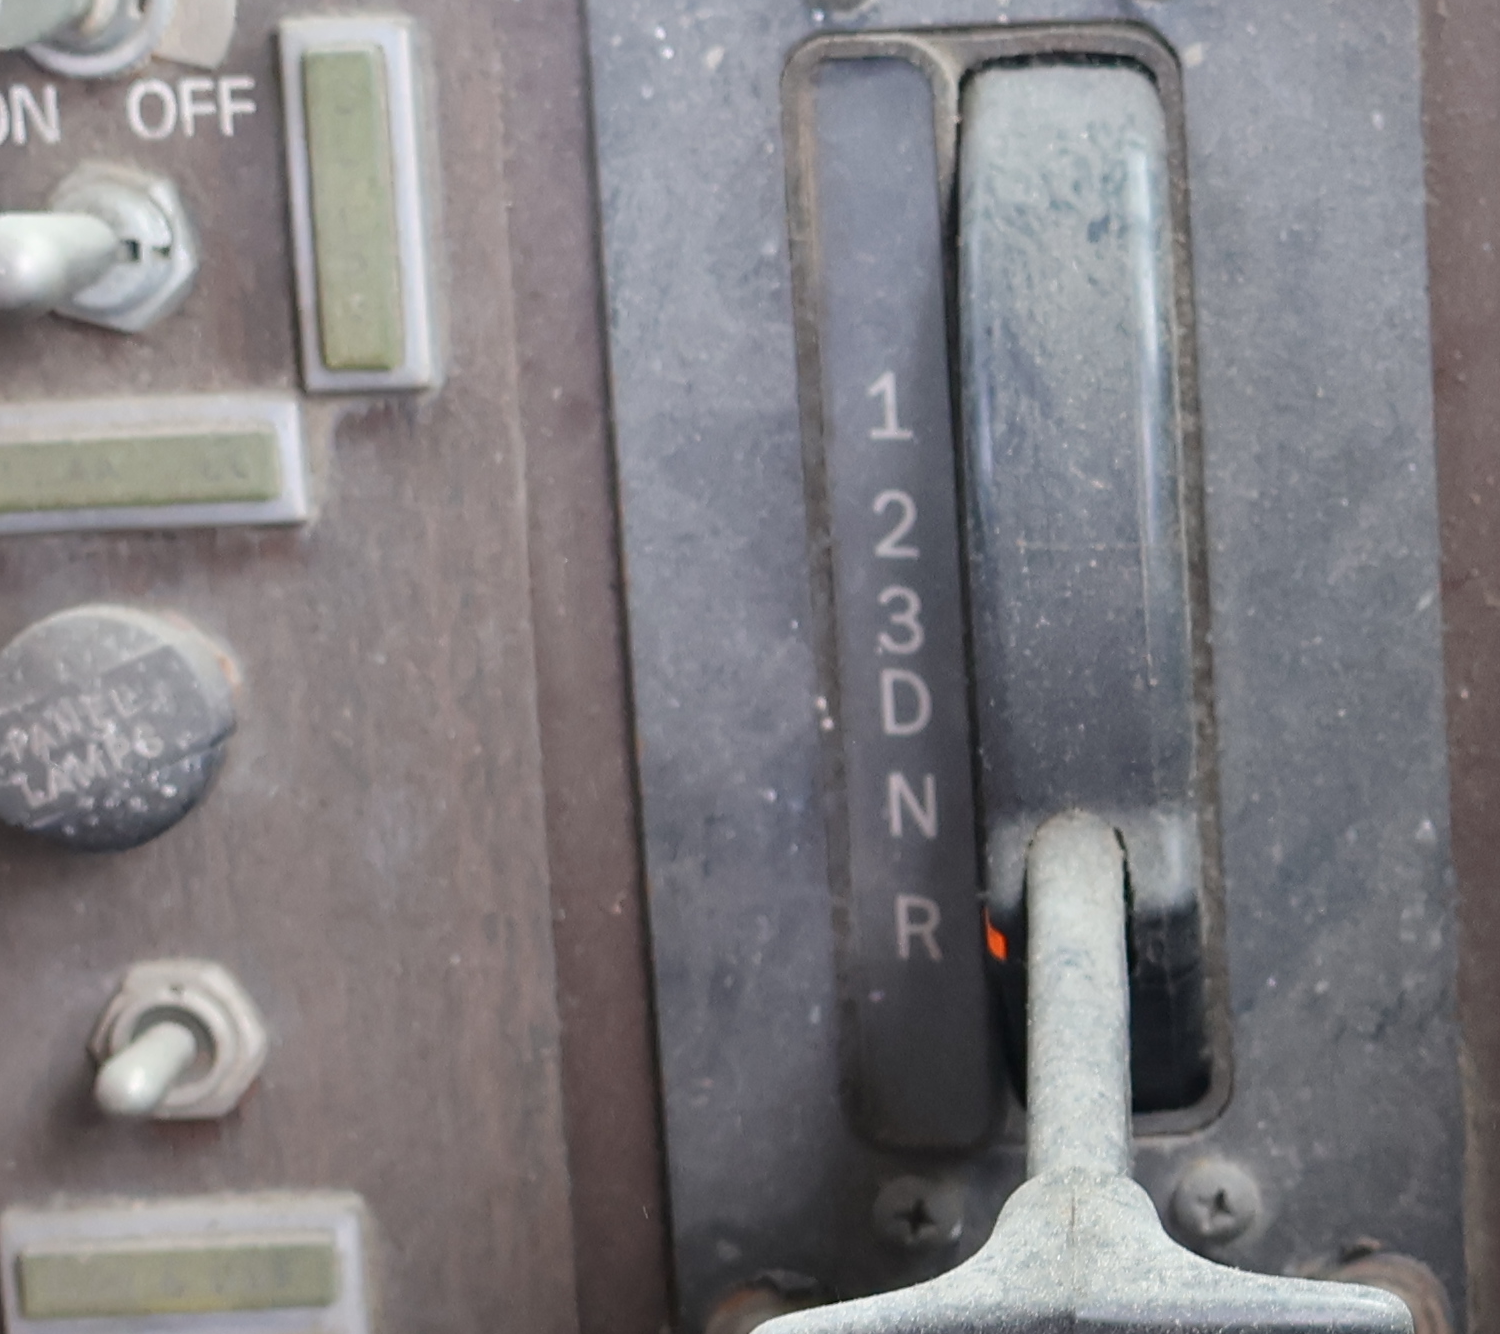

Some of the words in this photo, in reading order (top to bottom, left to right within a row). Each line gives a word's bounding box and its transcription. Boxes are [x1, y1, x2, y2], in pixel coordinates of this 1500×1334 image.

[127, 78, 256, 140] OFF
[868, 371, 913, 439] 1
[872, 491, 918, 558] 2
[876, 587, 924, 654] 3
[881, 670, 932, 734] D
[888, 773, 938, 837] N
[896, 895, 943, 960] R
